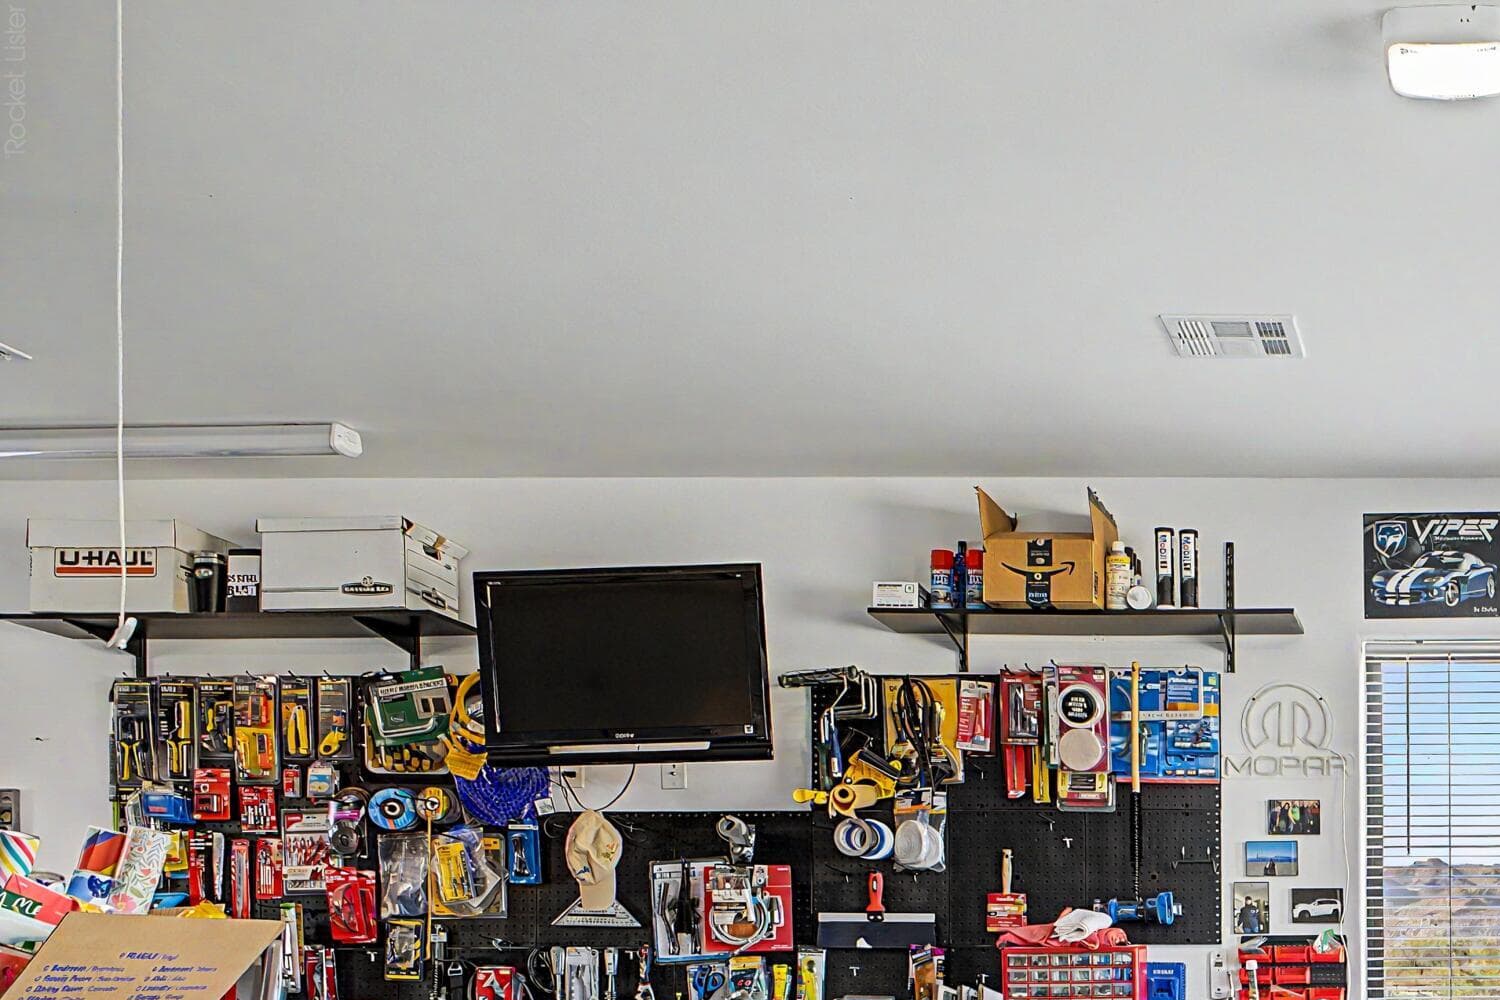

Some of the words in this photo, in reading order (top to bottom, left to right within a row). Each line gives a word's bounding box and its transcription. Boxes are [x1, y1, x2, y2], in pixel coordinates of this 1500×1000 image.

[1412, 519, 1499, 544] VIPER
[59, 550, 153, 566] U-HAUL
[1224, 756, 1349, 777] MOPAR
